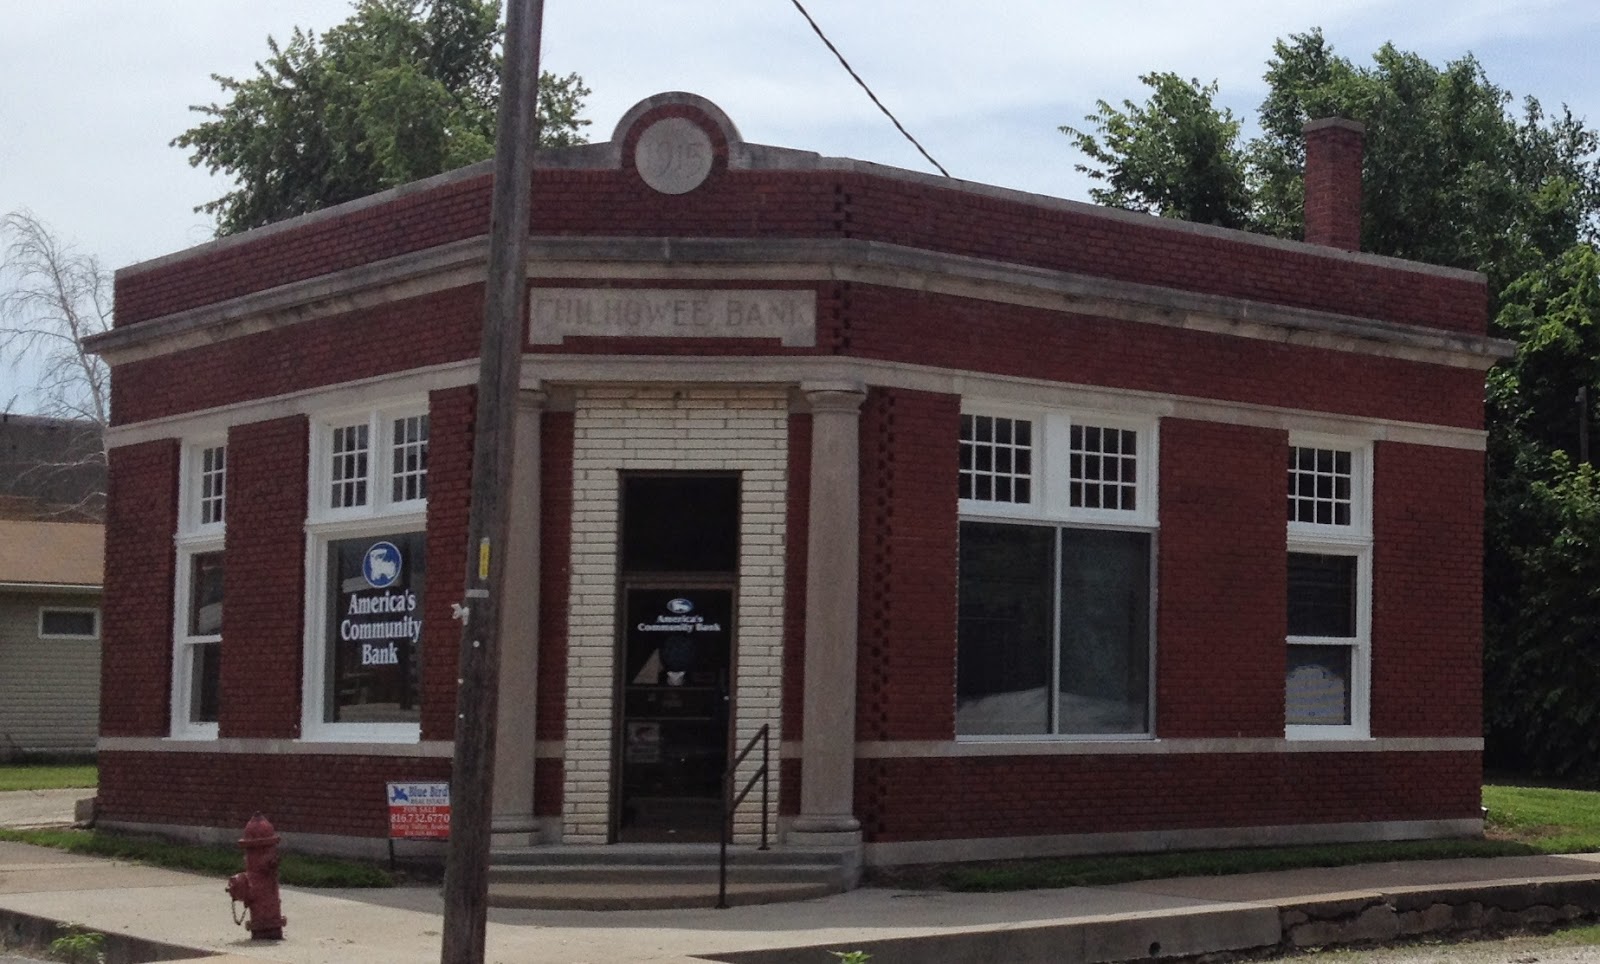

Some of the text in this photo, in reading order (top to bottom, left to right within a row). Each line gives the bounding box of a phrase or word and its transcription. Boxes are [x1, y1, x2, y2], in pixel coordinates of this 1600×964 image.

[726, 300, 809, 328] BANK
[348, 589, 416, 615] America's
[657, 615, 704, 623] America's
[341, 616, 422, 643] Community
[637, 623, 721, 633] Community Bank
[362, 642, 398, 665] Bank
[409, 786, 448, 797] Blue Bird
[390, 813, 450, 823] 816.732.6770
